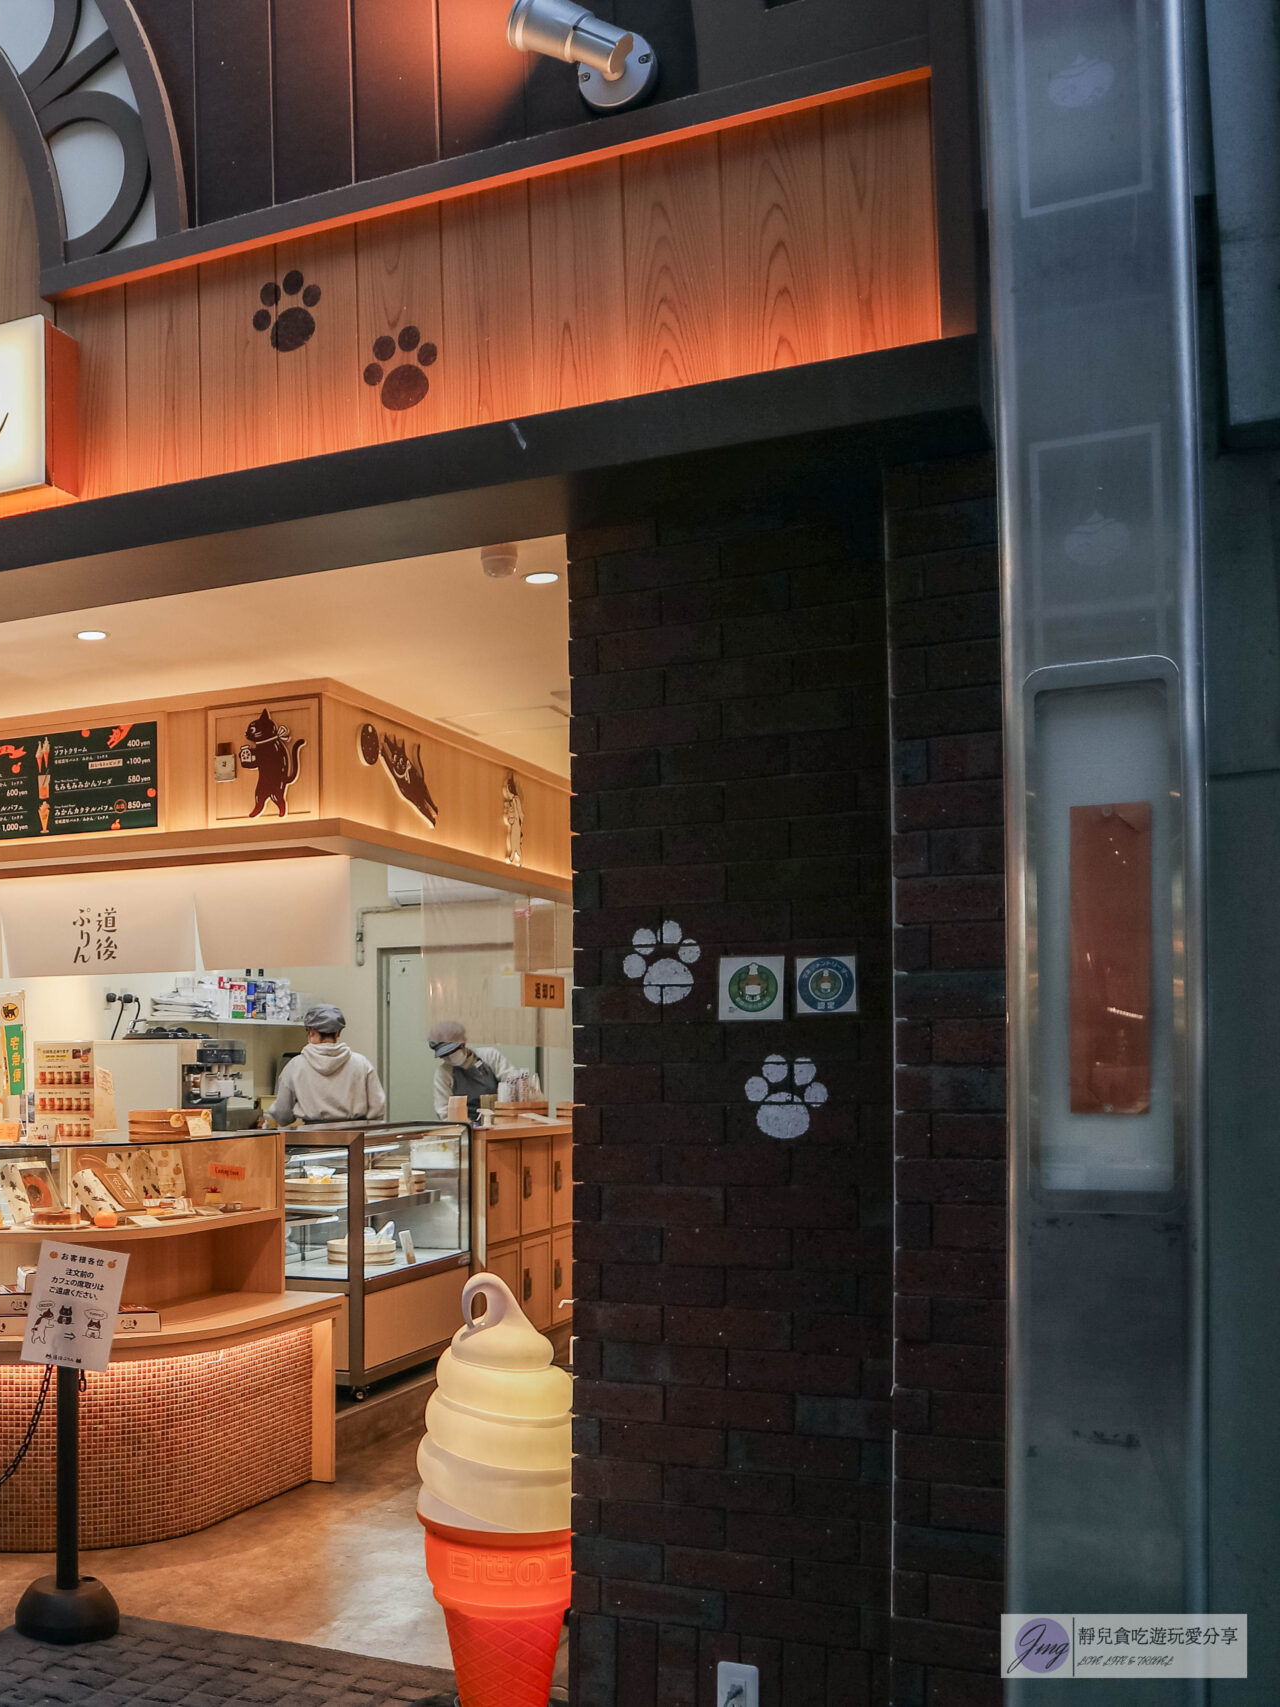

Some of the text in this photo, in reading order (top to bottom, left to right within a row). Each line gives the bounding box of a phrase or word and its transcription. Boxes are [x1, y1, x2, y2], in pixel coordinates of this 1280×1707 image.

[127, 739, 140, 747] 400
[127, 775, 140, 783] 580
[6, 788, 19, 797] 600
[127, 801, 140, 809] 850
[2, 822, 19, 832] 1,000
[72, 907, 91, 964] ぷりん
[96, 907, 118, 961] 道後
[61, 1253, 104, 1267] お客様各位
[66, 1267, 94, 1279] 注文前の
[51, 1276, 105, 1291] カフェの席取りは
[49, 1286, 99, 1300] ご遠慮ください。
